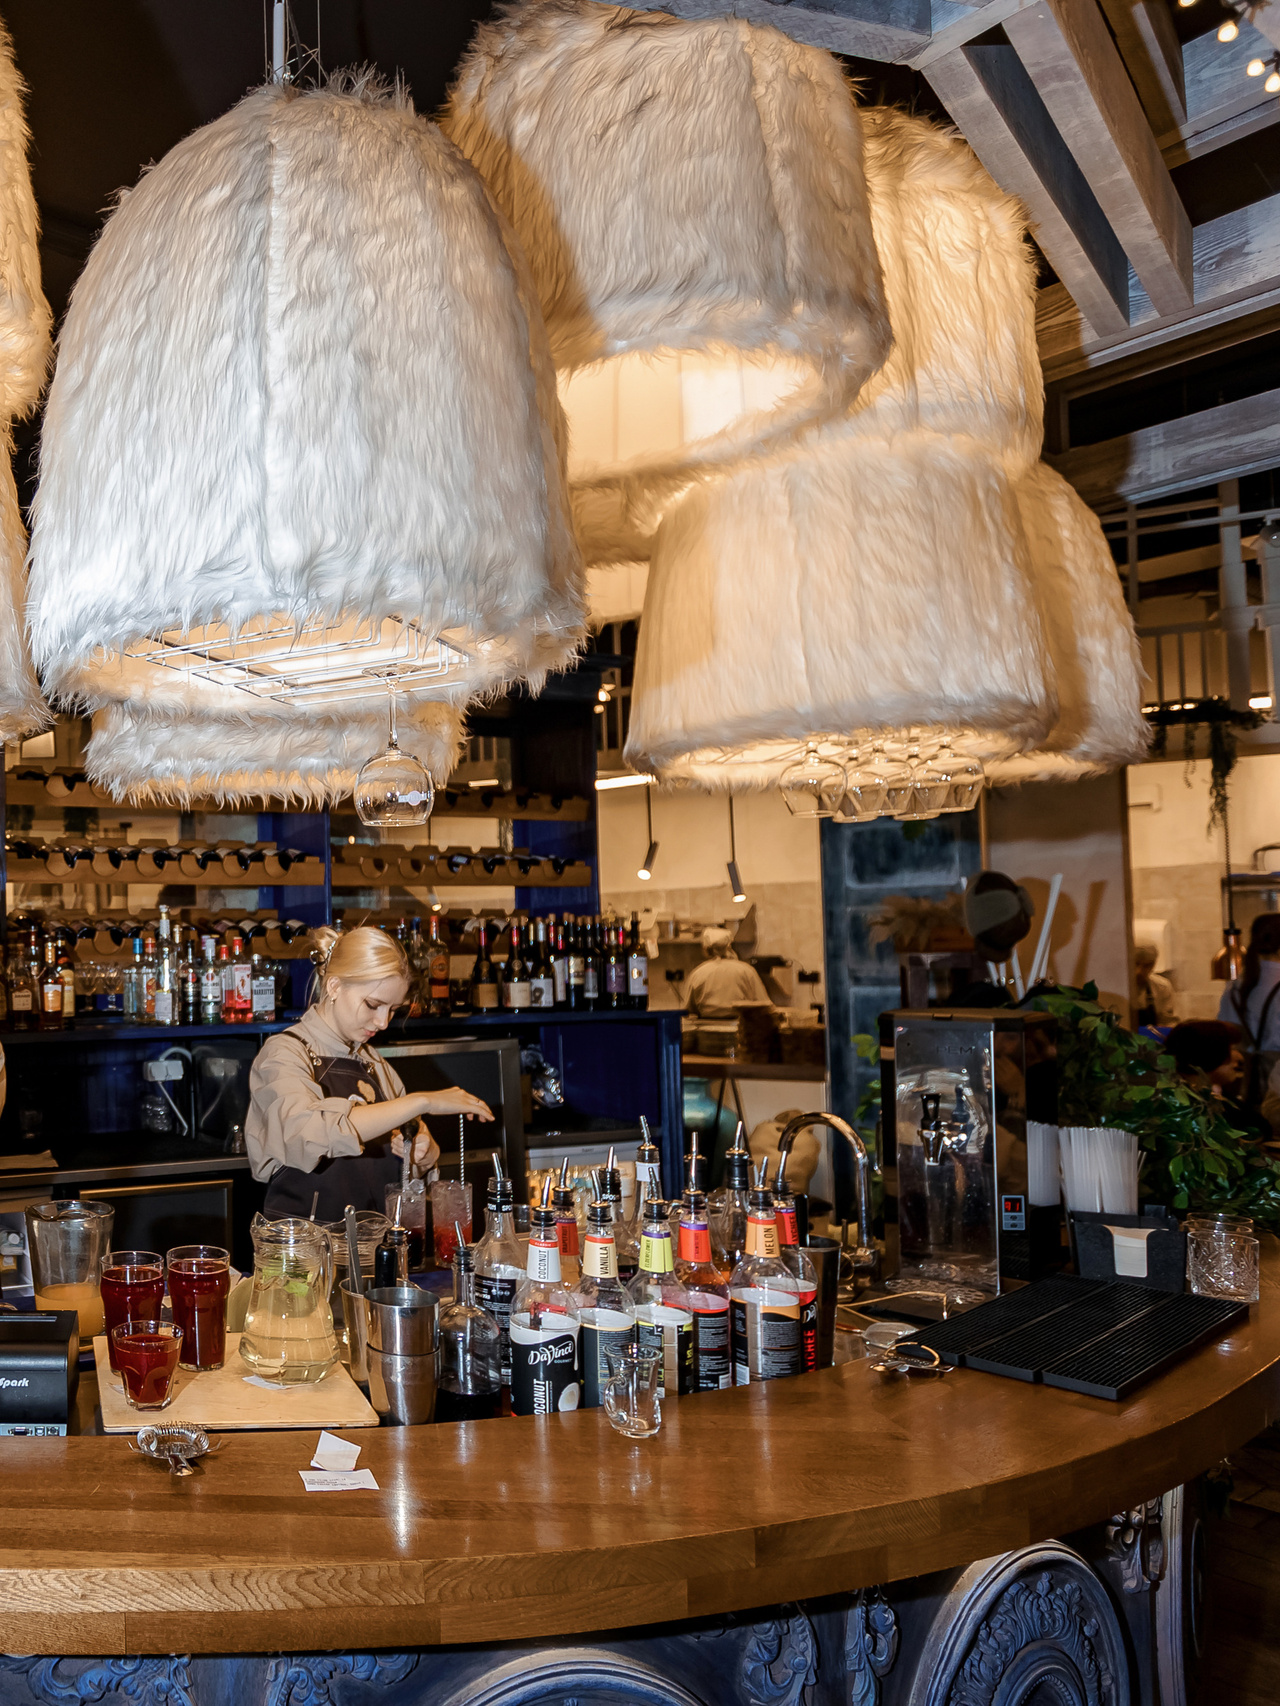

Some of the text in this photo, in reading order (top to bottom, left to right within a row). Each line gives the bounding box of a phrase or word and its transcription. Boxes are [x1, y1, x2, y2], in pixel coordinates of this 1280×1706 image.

[763, 1227, 775, 1255] MELON
[538, 1250, 548, 1280] COCONUT
[600, 1246, 610, 1275] VANILLA
[528, 1341, 574, 1366] DaVinci
[533, 1379, 546, 1415] OCONUT
